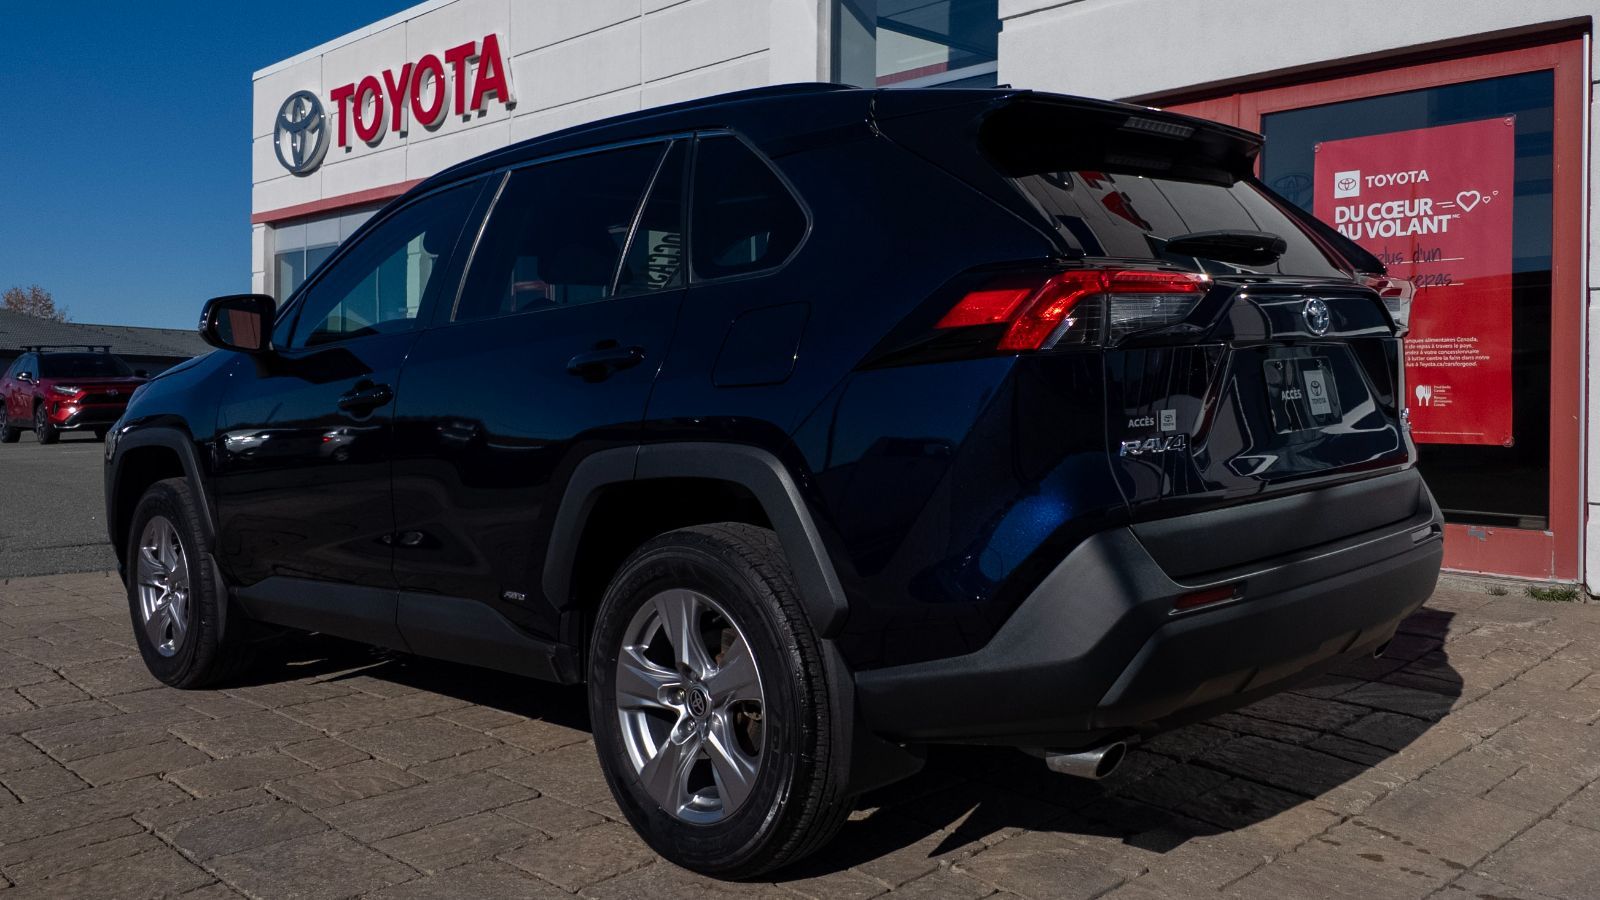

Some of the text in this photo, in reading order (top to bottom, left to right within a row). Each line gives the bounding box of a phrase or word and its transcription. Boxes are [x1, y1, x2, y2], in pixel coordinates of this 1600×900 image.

[330, 33, 510, 147] TOYOTA
[1365, 169, 1430, 188] TOYOTA
[1335, 198, 1434, 224] DU CŒUR
[1337, 222, 1362, 241] AU
[1364, 214, 1452, 239] VOLANT
[1128, 415, 1155, 428] ACCÈS
[1120, 434, 1186, 457] RAV4
